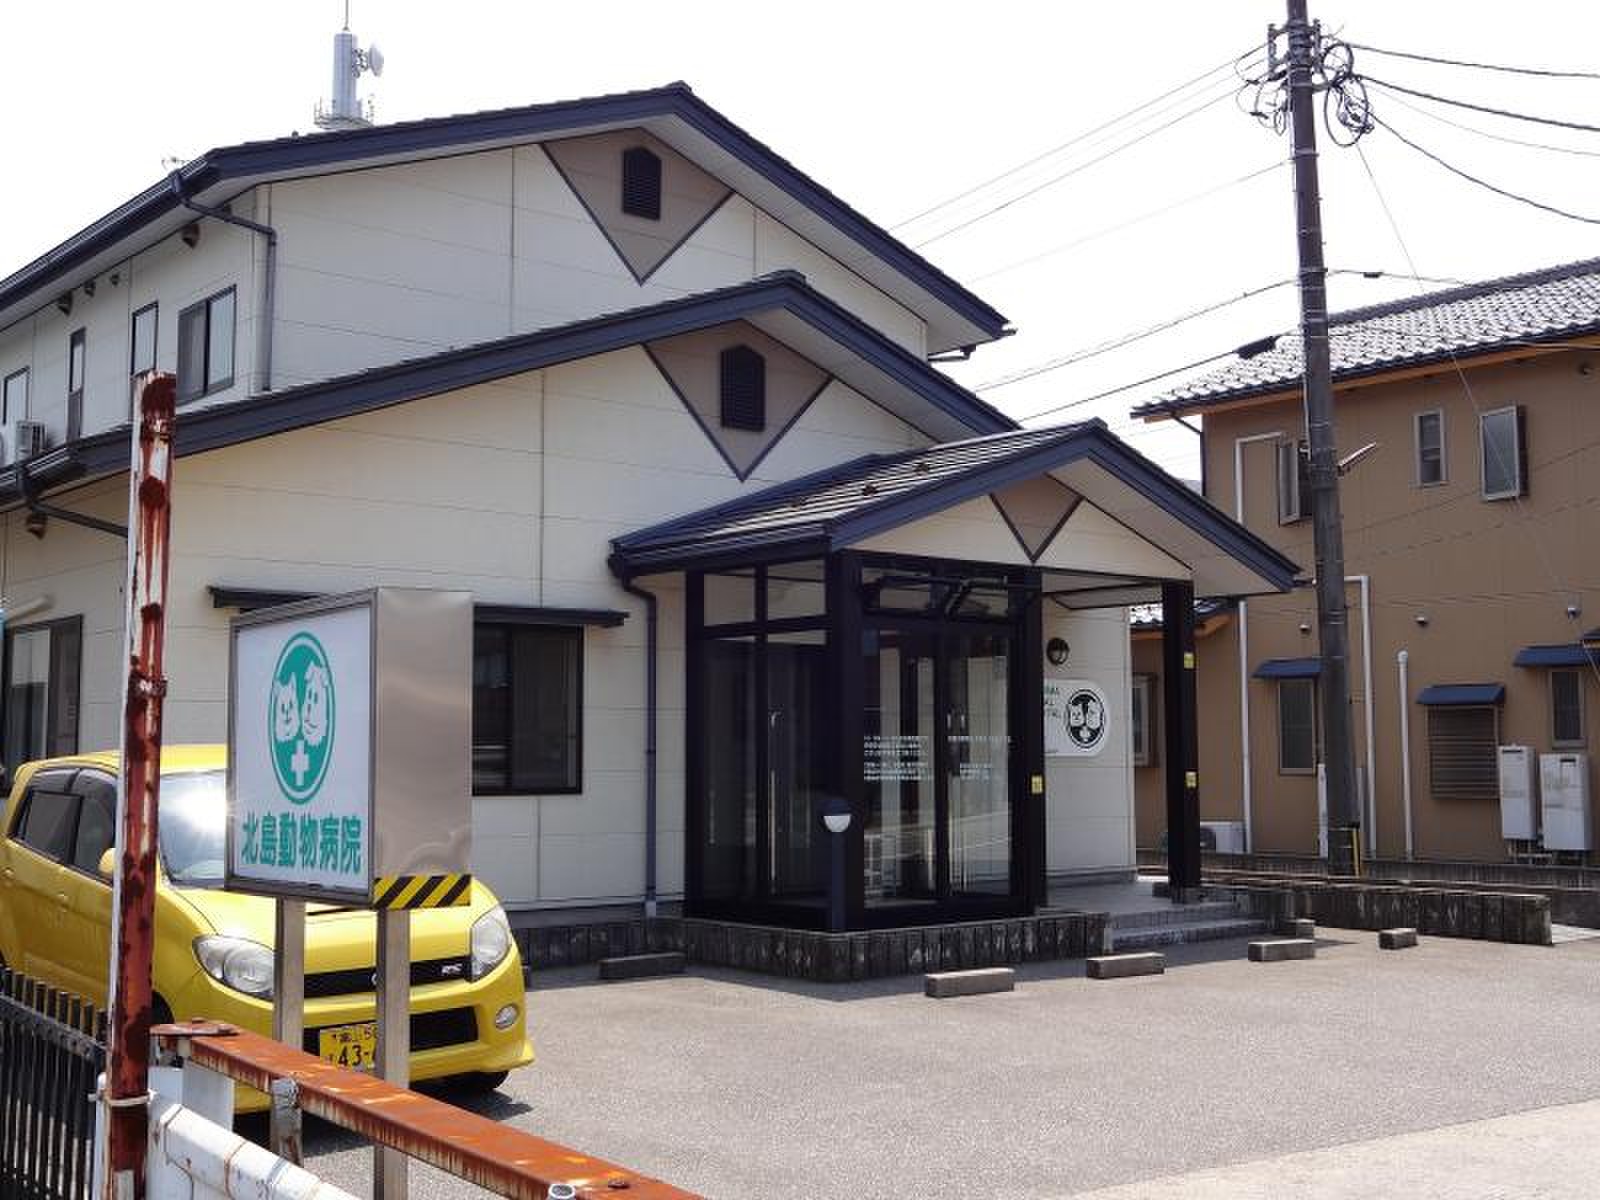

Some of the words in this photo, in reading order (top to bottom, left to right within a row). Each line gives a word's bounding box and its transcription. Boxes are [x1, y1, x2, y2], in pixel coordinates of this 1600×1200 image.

[241, 812, 362, 874] 北島動物病院
